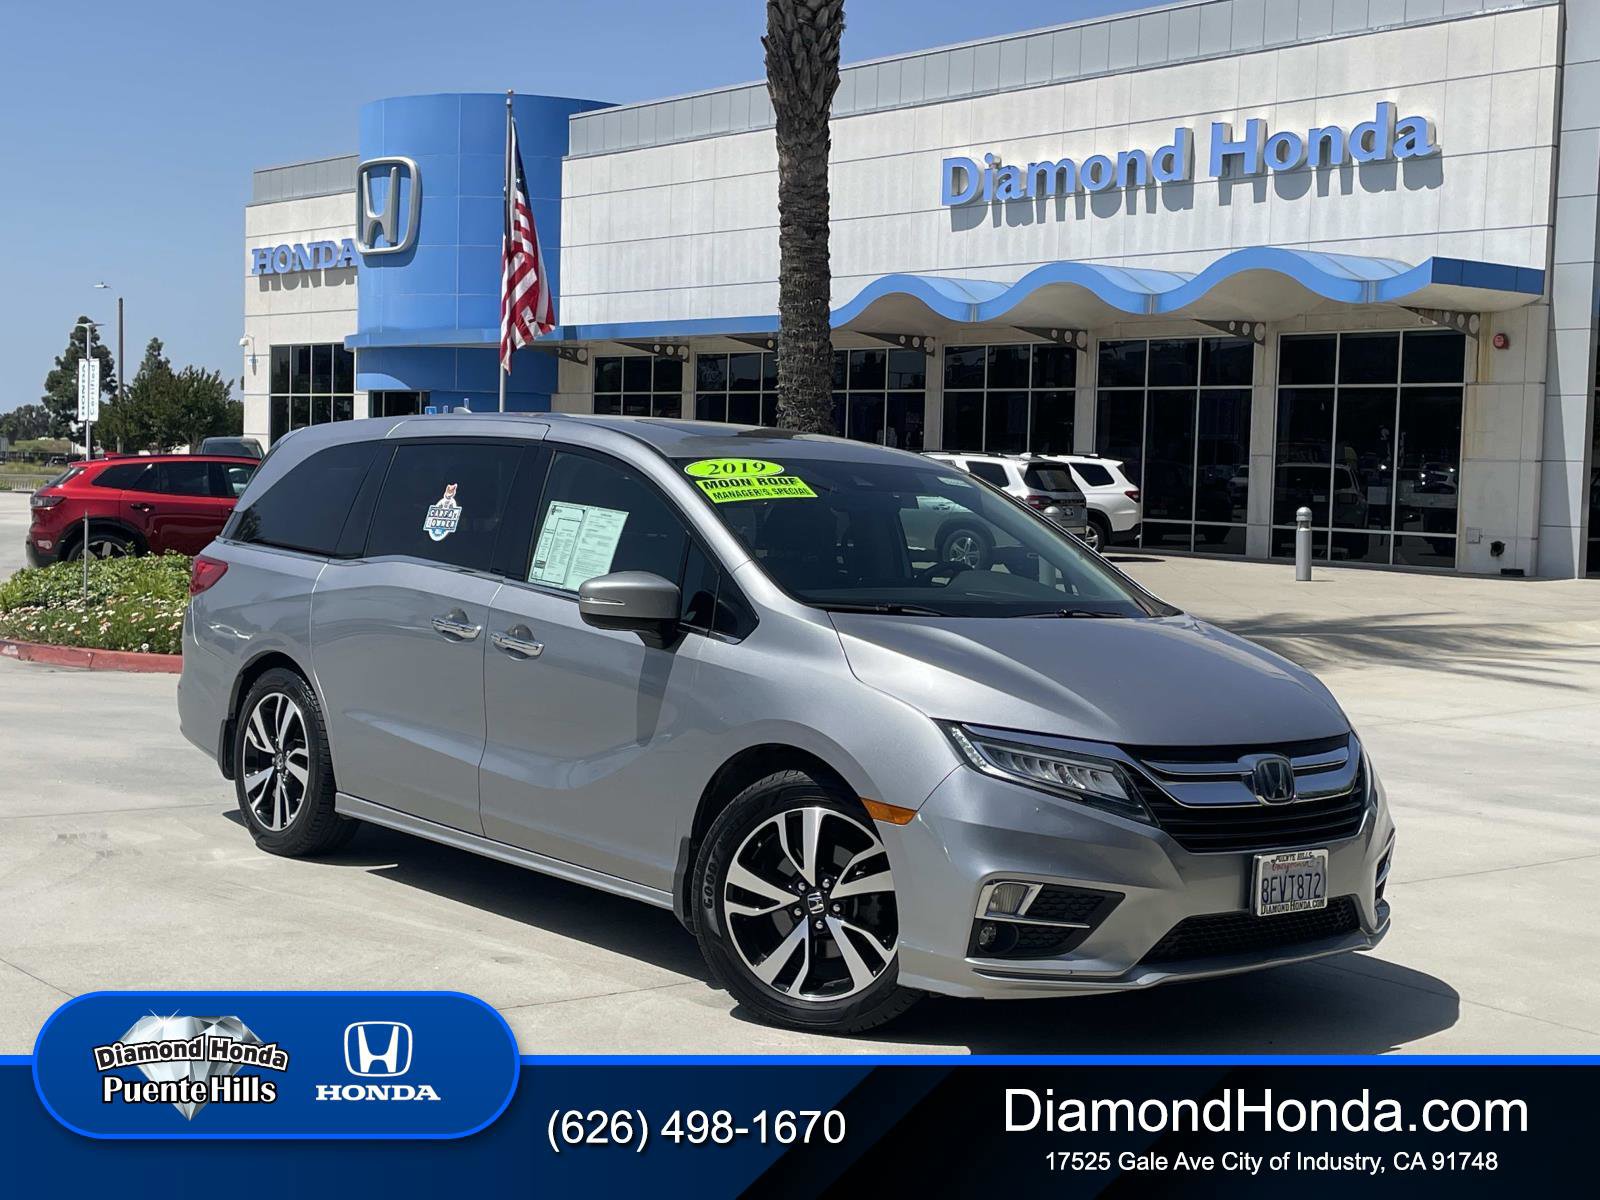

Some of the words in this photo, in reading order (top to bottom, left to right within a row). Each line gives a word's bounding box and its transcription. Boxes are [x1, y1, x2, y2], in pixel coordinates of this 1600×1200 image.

[941, 127, 1194, 207] Diamond
[1209, 101, 1435, 178] Honda
[251, 238, 358, 275] HONDA
[707, 462, 766, 476] 2019
[703, 478, 752, 490] MOON
[755, 476, 798, 486] ROOF
[773, 486, 812, 496] SPECIAL
